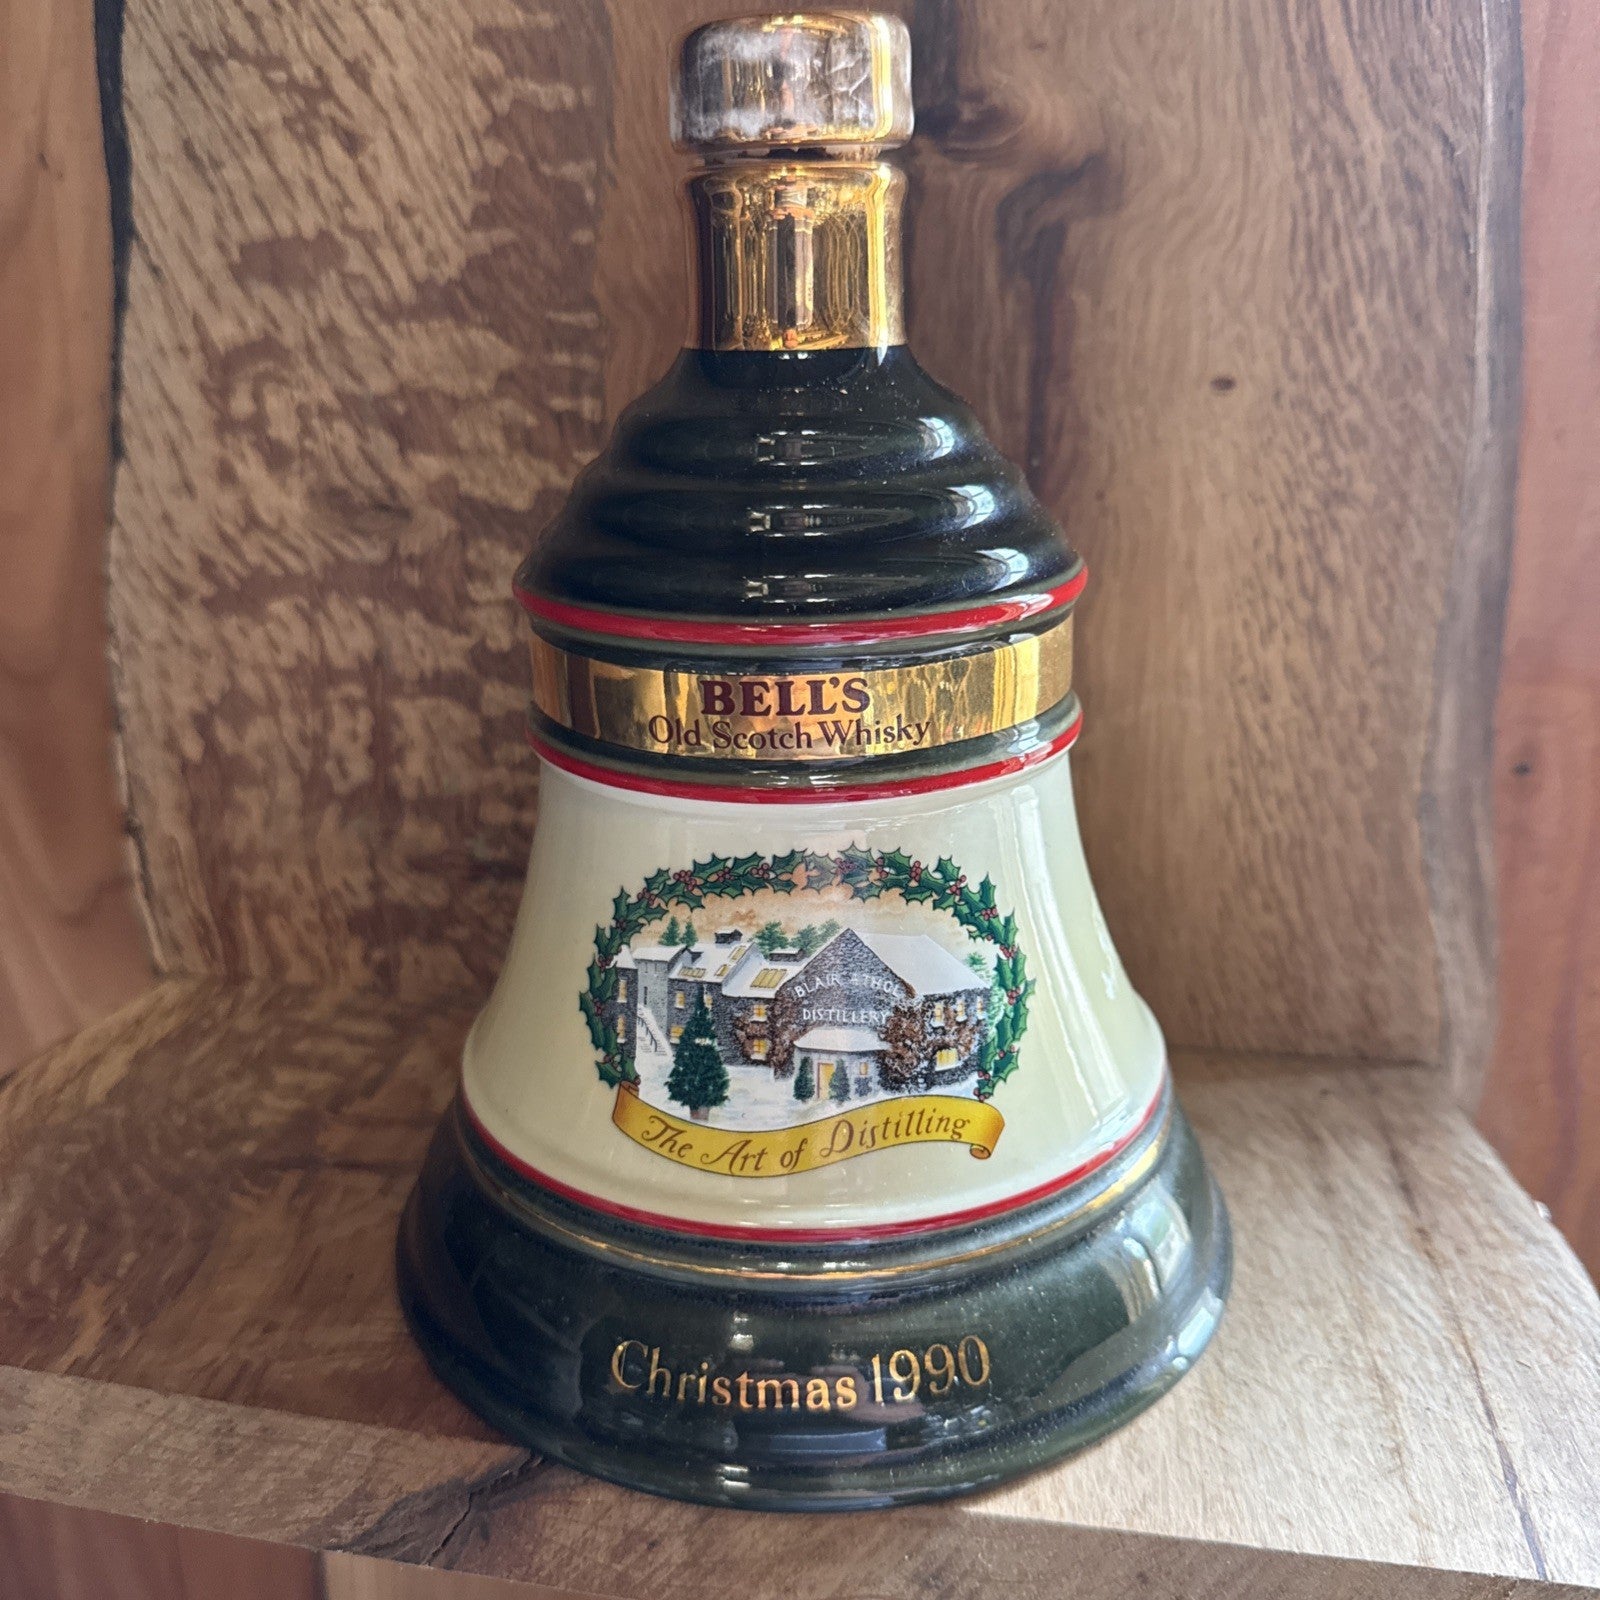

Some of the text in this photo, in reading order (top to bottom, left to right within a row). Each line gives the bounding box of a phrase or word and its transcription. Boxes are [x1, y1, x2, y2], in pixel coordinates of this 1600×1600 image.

[701, 677, 871, 716] BELL'S
[649, 714, 932, 749] Old Scotch Whisky
[794, 972, 841, 998] BLAIR
[802, 1008, 888, 1024] DISTILLERY
[641, 1107, 971, 1173] The Art of Distilling
[611, 1334, 992, 1412] Christmas 1990
